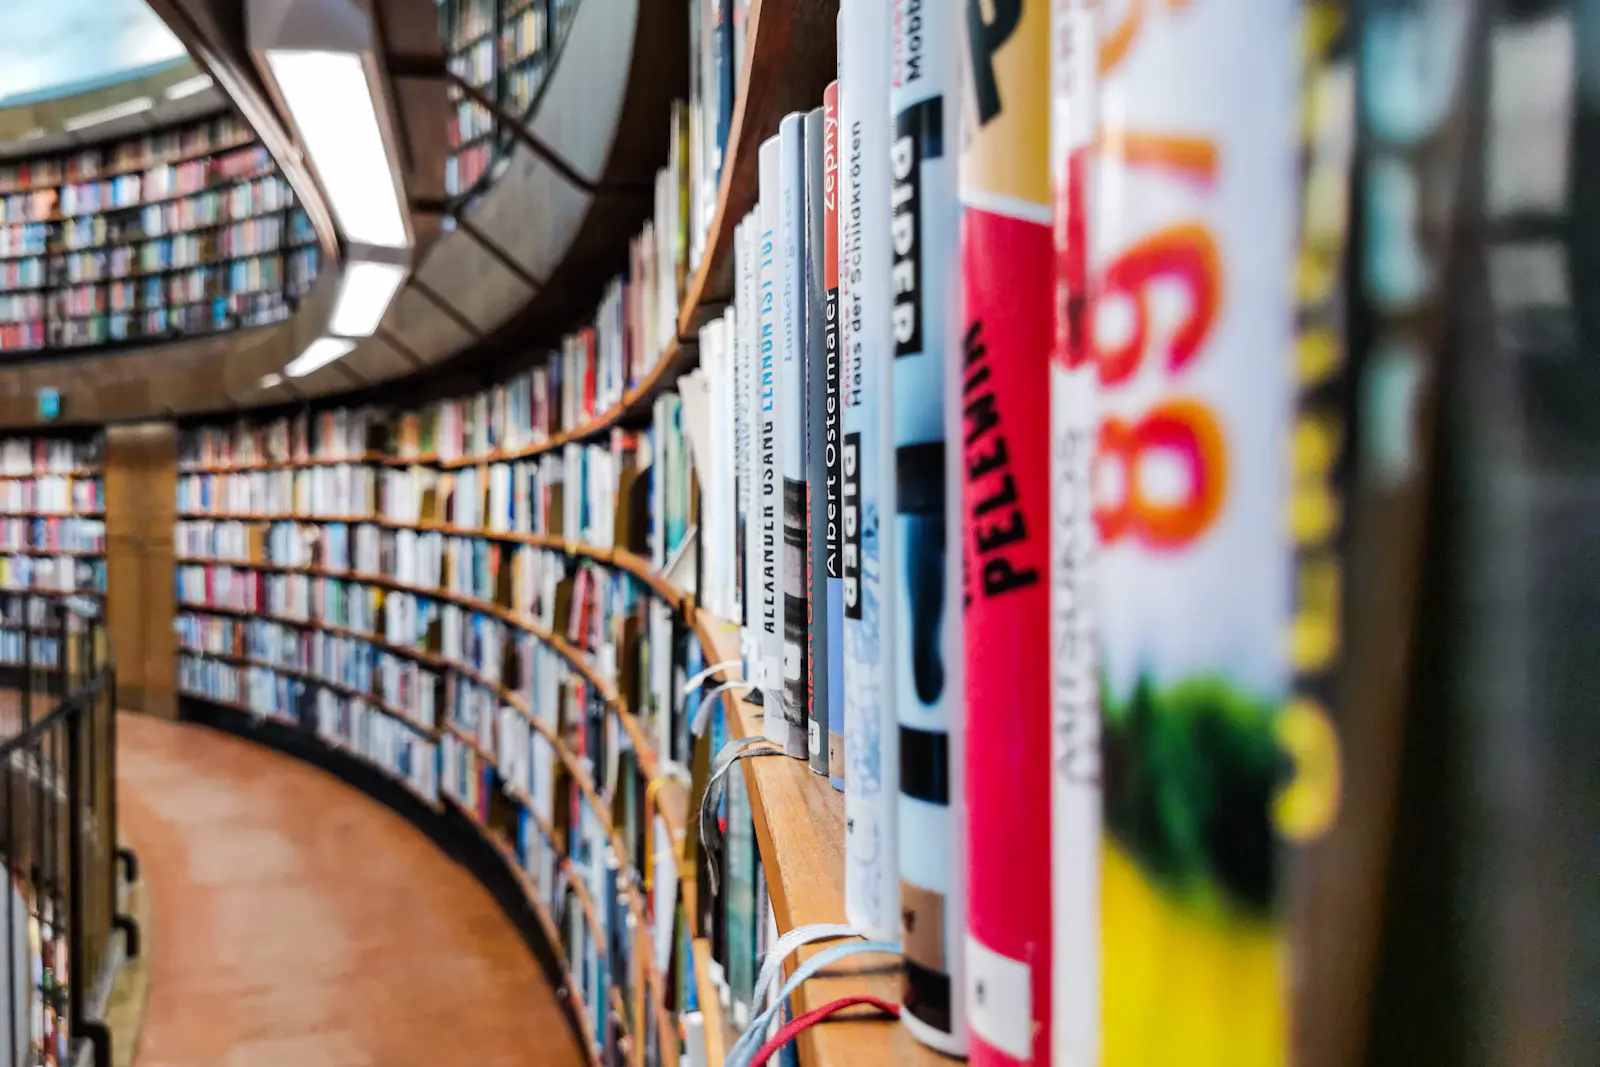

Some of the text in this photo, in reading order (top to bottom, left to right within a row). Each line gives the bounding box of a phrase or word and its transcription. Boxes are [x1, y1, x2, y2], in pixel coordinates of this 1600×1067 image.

[823, 104, 838, 211] Zephyr
[849, 121, 863, 406] Haus der Schildkröten
[892, 136, 915, 343] PIPER
[762, 323, 773, 412] LENNON
[824, 290, 837, 577] Albert Ostermaier
[763, 421, 774, 496] OSANG
[844, 443, 857, 607] PIPER
[962, 319, 1040, 598] PELEWIN
[763, 506, 775, 633] ALEXANDER
[808, 633, 816, 717] Albert
